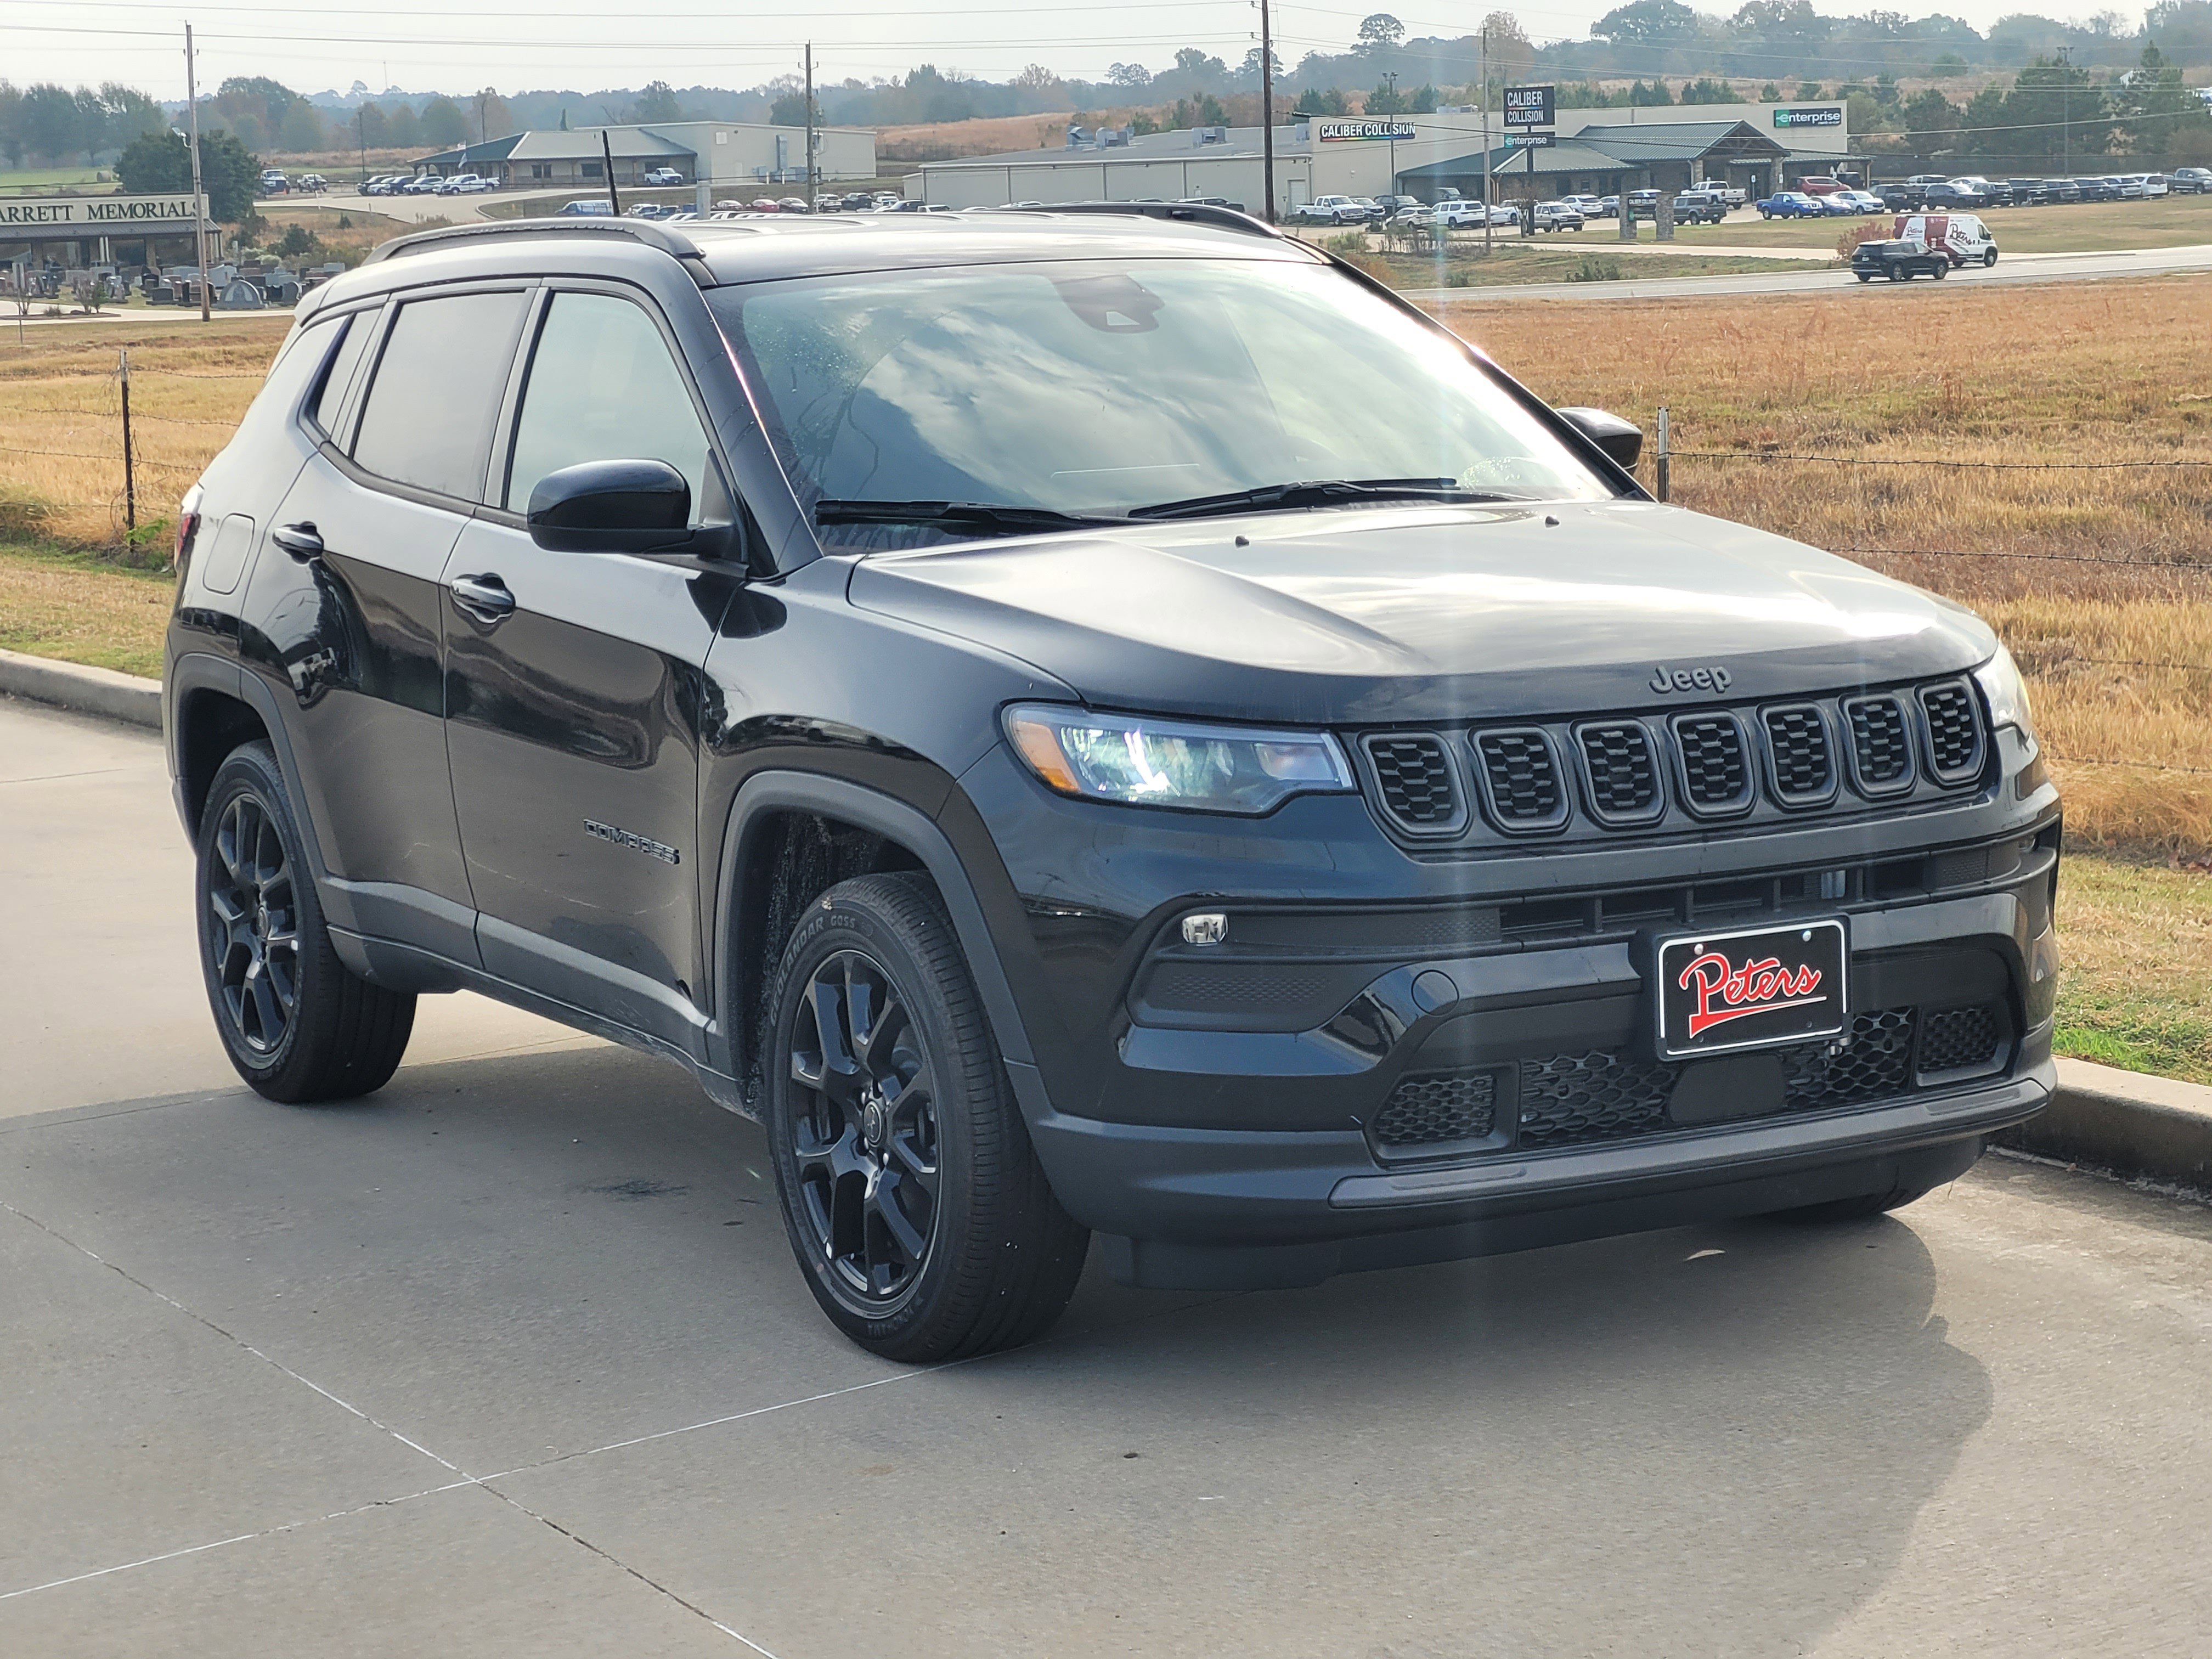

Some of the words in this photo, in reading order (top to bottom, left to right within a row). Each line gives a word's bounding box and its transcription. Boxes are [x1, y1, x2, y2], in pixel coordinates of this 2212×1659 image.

[1507, 91, 1543, 106] CALIBER
[1508, 110, 1544, 123] COLLISION
[1776, 111, 1840, 124] enterprise
[1321, 125, 1363, 137] CALIBER
[1365, 122, 1415, 136] COLLSION
[1505, 137, 1547, 146] enterprise
[87, 201, 196, 219] MEMORIAL
[1649, 665, 1732, 693] Jeep
[583, 819, 680, 865] COMPASS
[770, 917, 823, 1027] GEOLANDAR
[1679, 952, 1822, 1025] Peters
